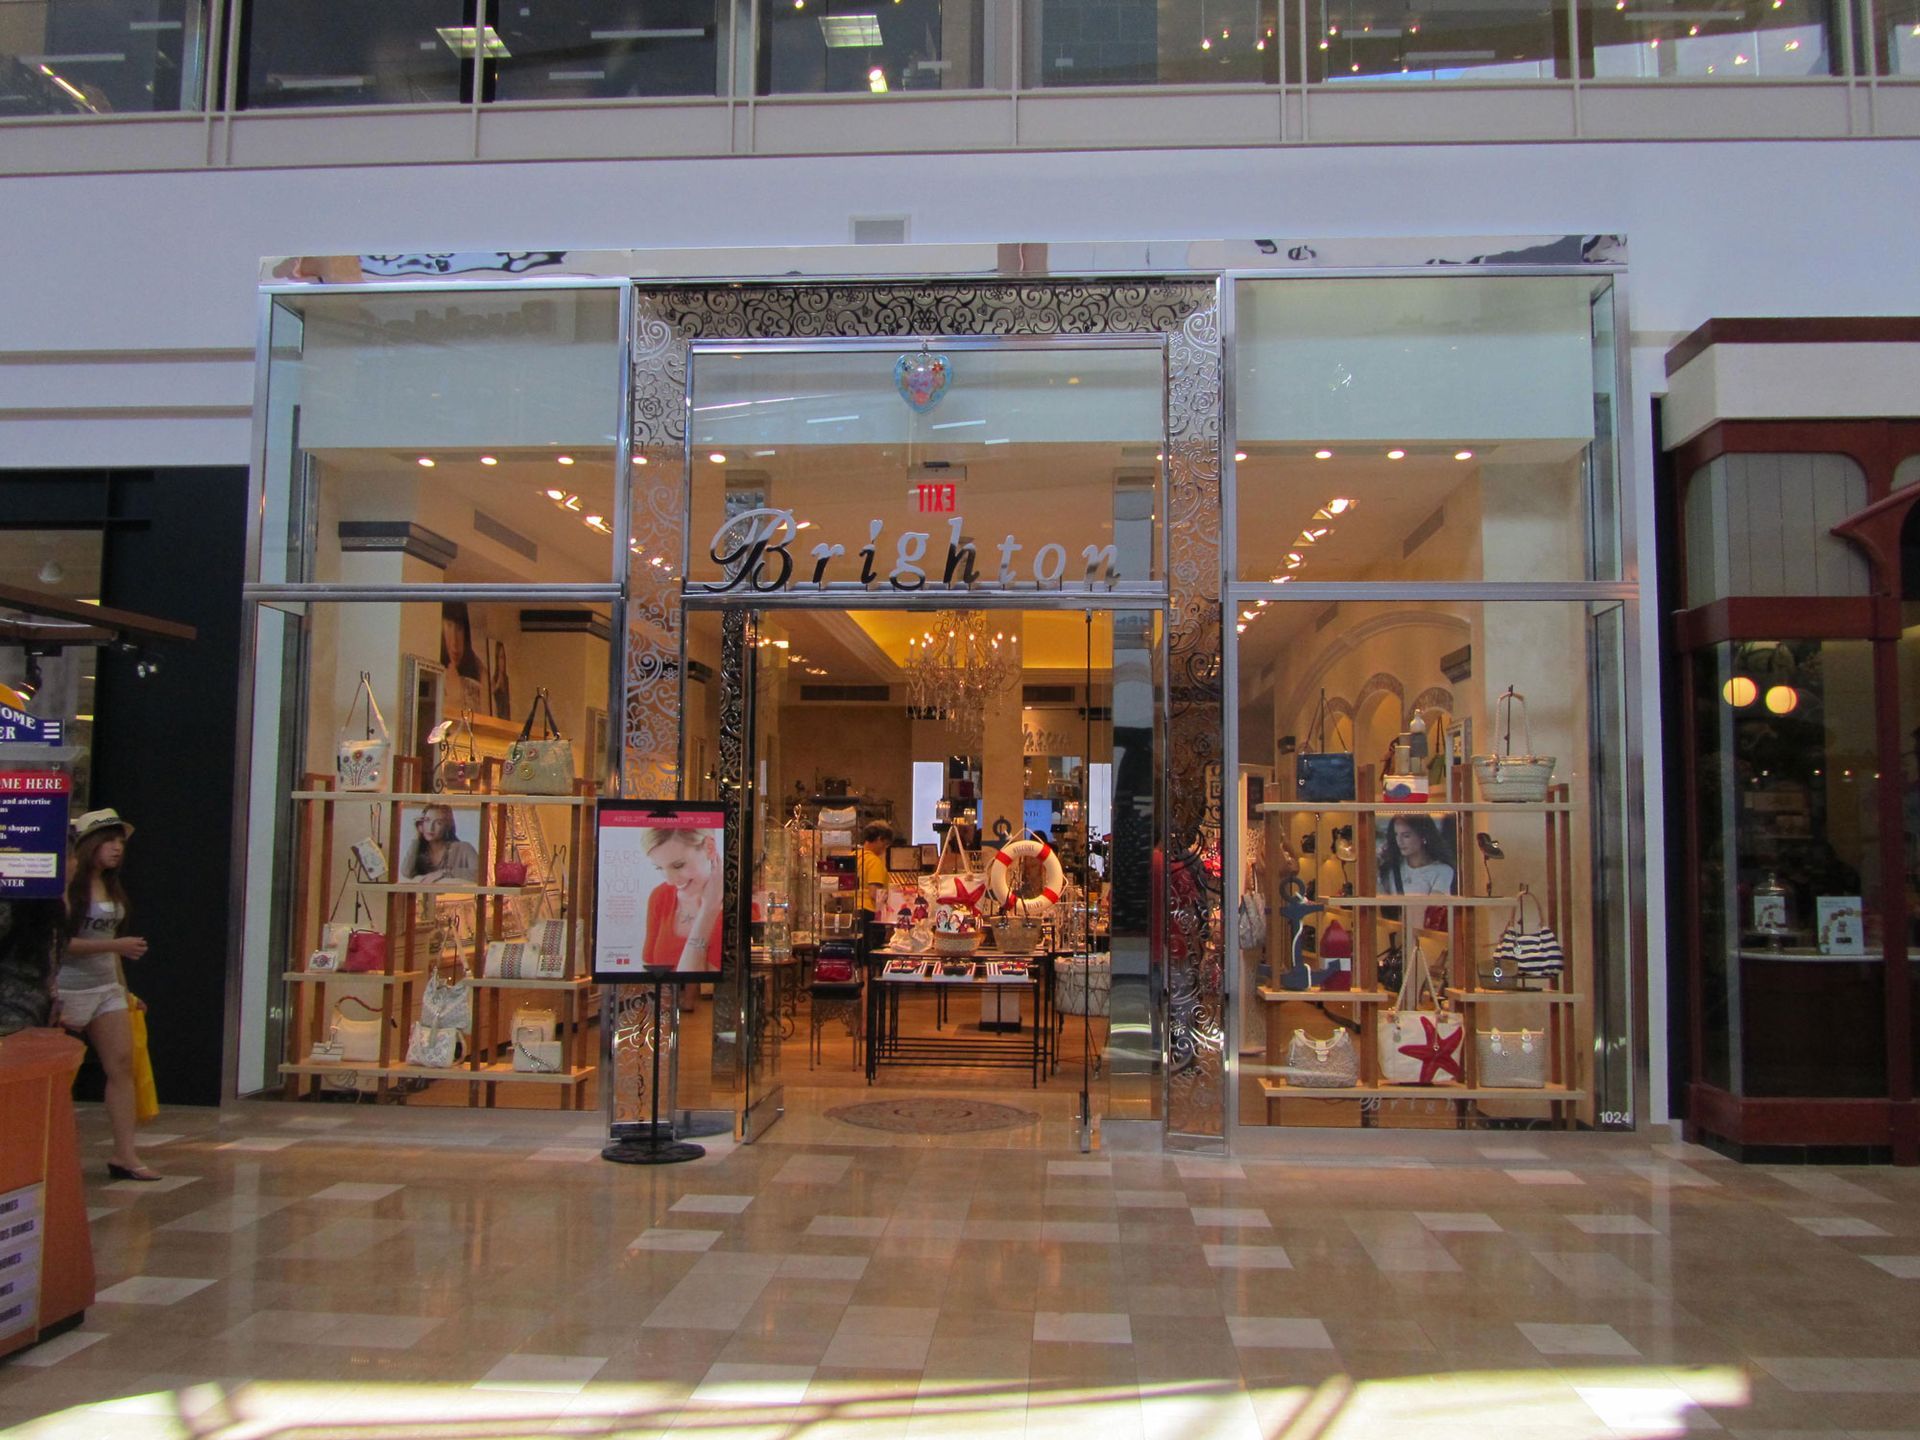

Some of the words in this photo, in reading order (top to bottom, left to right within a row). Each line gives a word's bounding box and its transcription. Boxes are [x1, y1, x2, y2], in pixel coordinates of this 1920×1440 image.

[704, 508, 1122, 593] Brighton
[0, 706, 36, 730] OME
[0, 778, 21, 789] ME
[26, 778, 62, 789] HERE
[18, 797, 52, 805] advertise
[8, 824, 40, 833] shoppers
[1599, 1111, 1630, 1124] 1024
